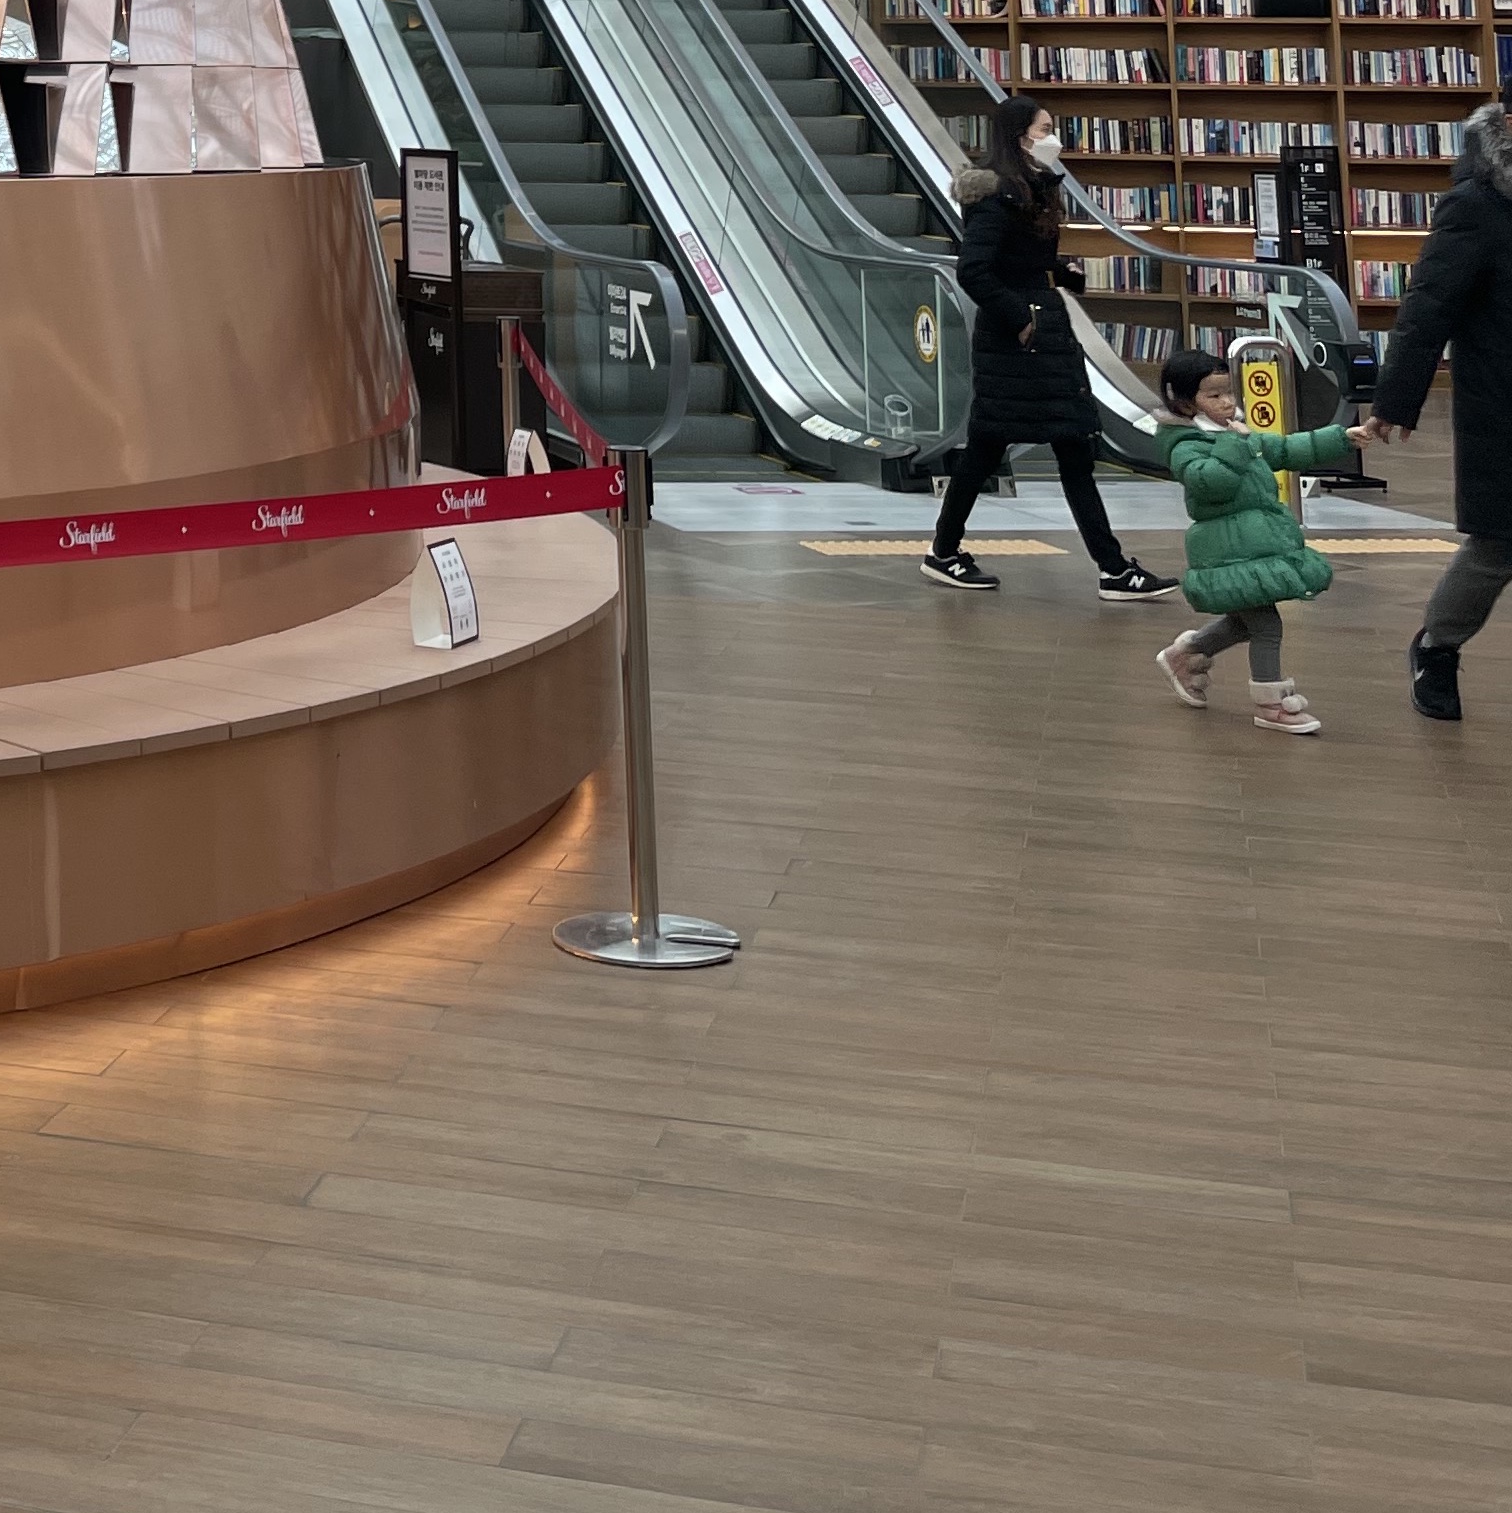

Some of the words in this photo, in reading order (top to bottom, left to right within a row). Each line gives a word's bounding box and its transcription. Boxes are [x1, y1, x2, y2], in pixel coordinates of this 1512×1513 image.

[436, 487, 486, 520] Starfield
[59, 521, 116, 552] Starfield
[251, 504, 304, 537] Starfield
